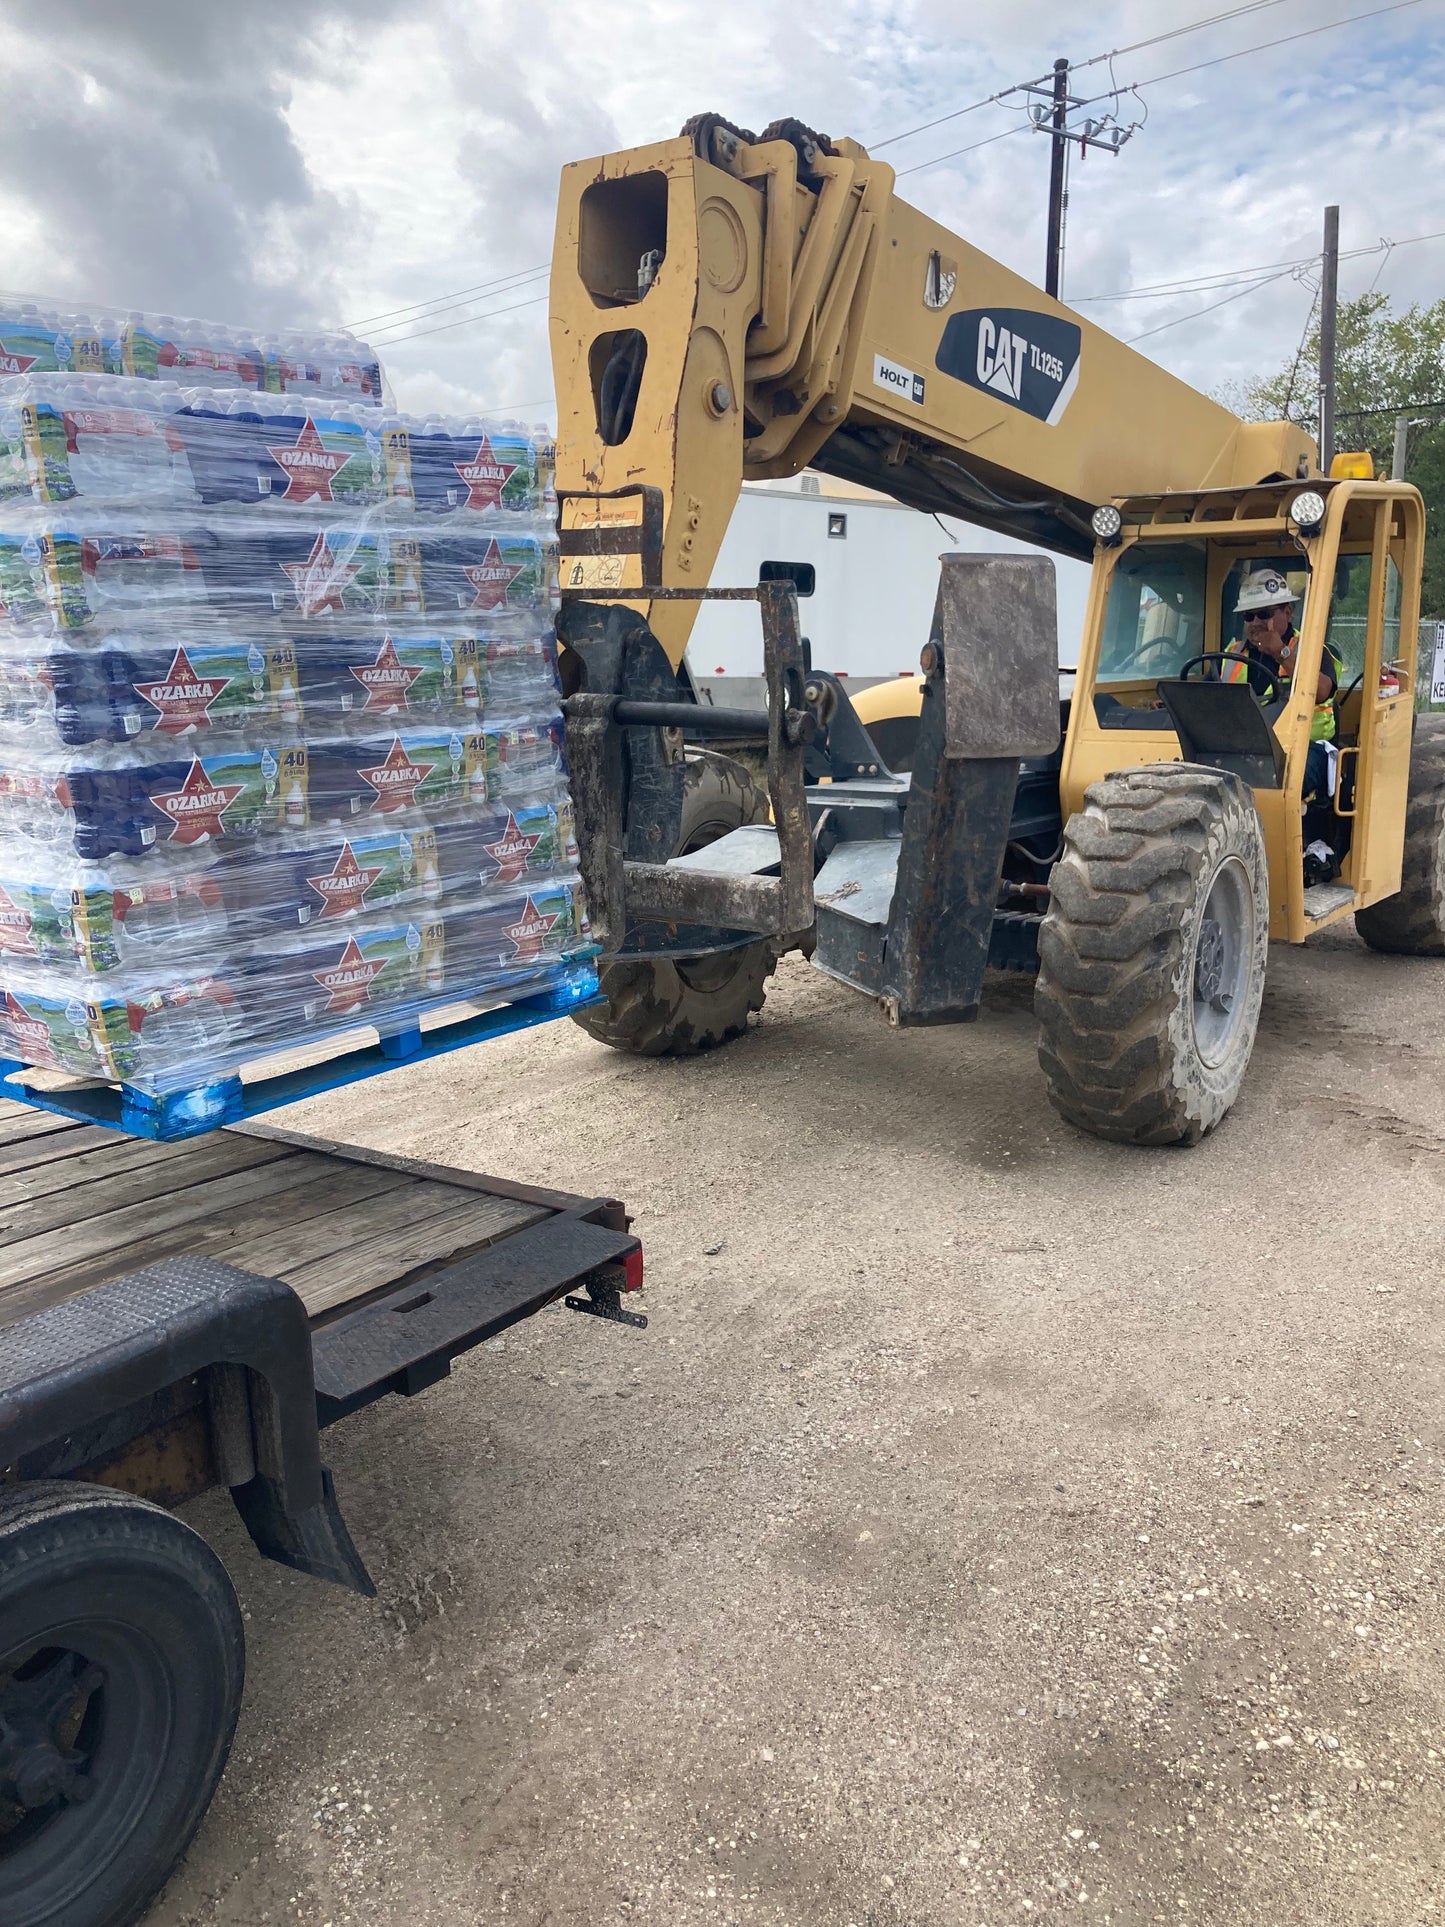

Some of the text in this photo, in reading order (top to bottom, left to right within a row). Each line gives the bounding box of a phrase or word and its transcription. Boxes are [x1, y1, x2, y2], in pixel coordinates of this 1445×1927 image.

[80, 340, 101, 356] 40
[976, 316, 1064, 401] CAT TL1255
[880, 366, 924, 397] HOLT CAT
[22, 407, 32, 425] 0
[389, 433, 407, 449] 40
[281, 451, 337, 471] OZARKA
[463, 466, 506, 481] OZARKA
[41, 536, 50, 555] 0
[471, 567, 512, 583] OZARKA
[460, 639, 476, 655] 40
[271, 649, 294, 664] 40
[362, 669, 412, 683] OZARKA
[150, 682, 214, 701] OZARKA
[469, 736, 486, 752] 40
[284, 751, 305, 767] 40
[371, 767, 421, 784] OZARKA
[166, 790, 227, 813] OZARKA
[418, 834, 435, 849] 40
[494, 838, 532, 857] OZARKA
[320, 872, 370, 891] OZARKA
[72, 890, 80, 906] 0
[427, 924, 443, 939] 40
[511, 919, 549, 939] OZARKA
[324, 964, 375, 986] OZARKA
[87, 1005, 98, 1021] 0
